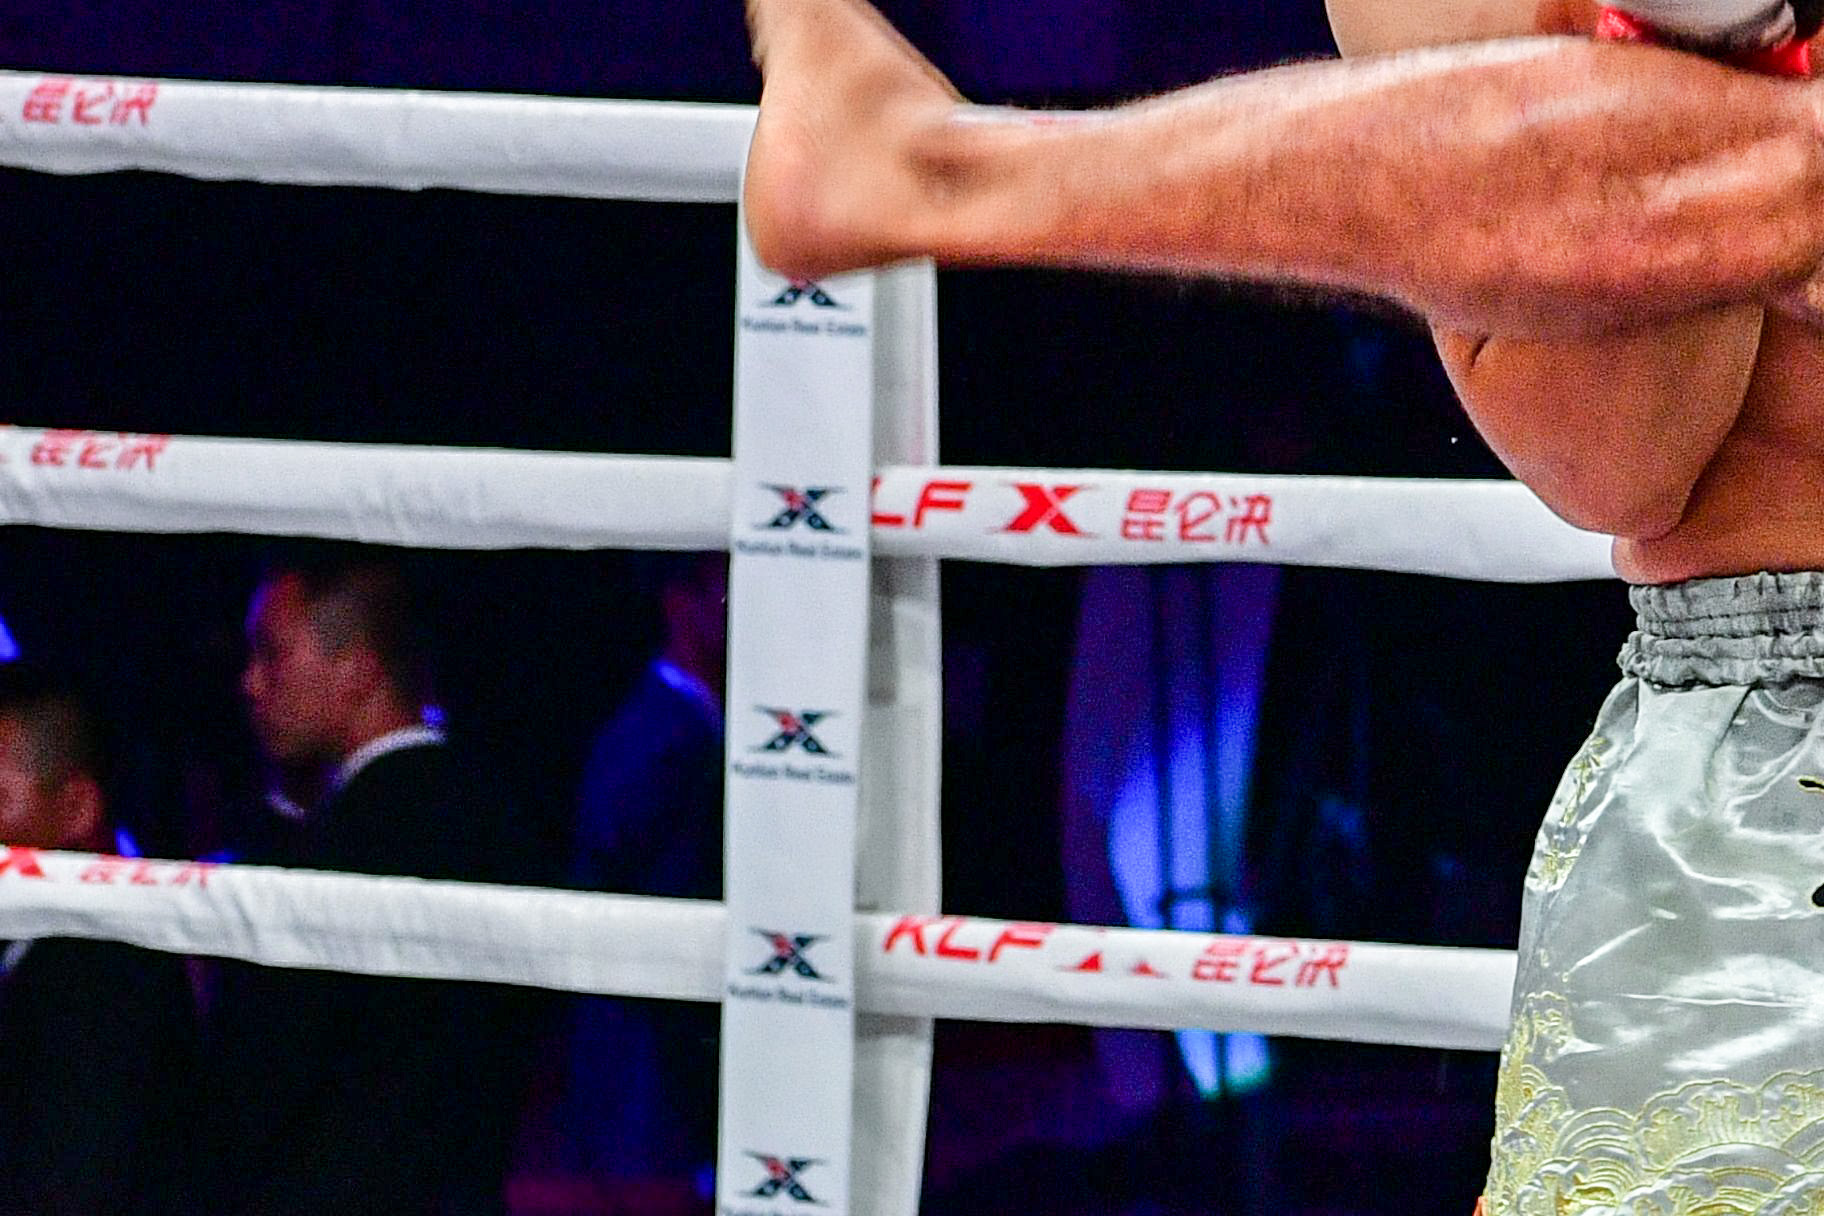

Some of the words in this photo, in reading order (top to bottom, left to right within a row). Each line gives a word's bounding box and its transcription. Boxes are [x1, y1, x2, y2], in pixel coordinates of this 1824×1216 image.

[871, 478, 974, 528] LF
[1120, 489, 1273, 544] 昆仑决
[884, 916, 1055, 962] KLF
